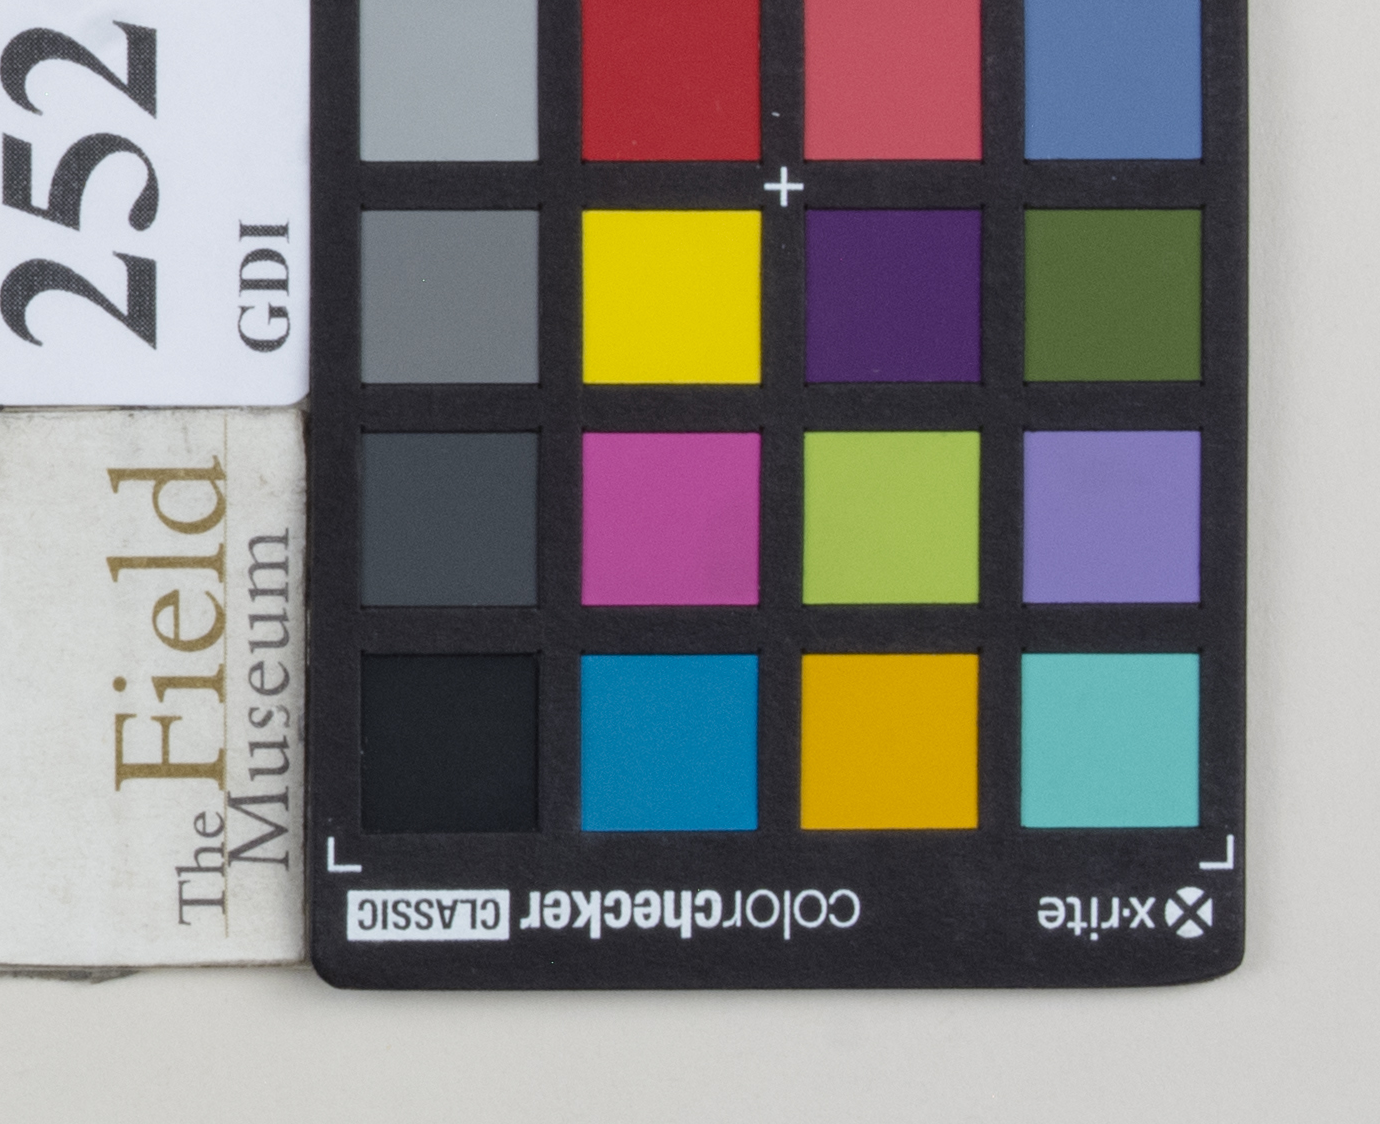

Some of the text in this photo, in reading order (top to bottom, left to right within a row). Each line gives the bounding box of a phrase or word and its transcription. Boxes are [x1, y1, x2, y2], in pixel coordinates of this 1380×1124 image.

[237, 218, 291, 353] GDI
[106, 454, 228, 926] The Field
[228, 528, 291, 872] Museum
[358, 888, 861, 940] colorchecker CLASSIC
